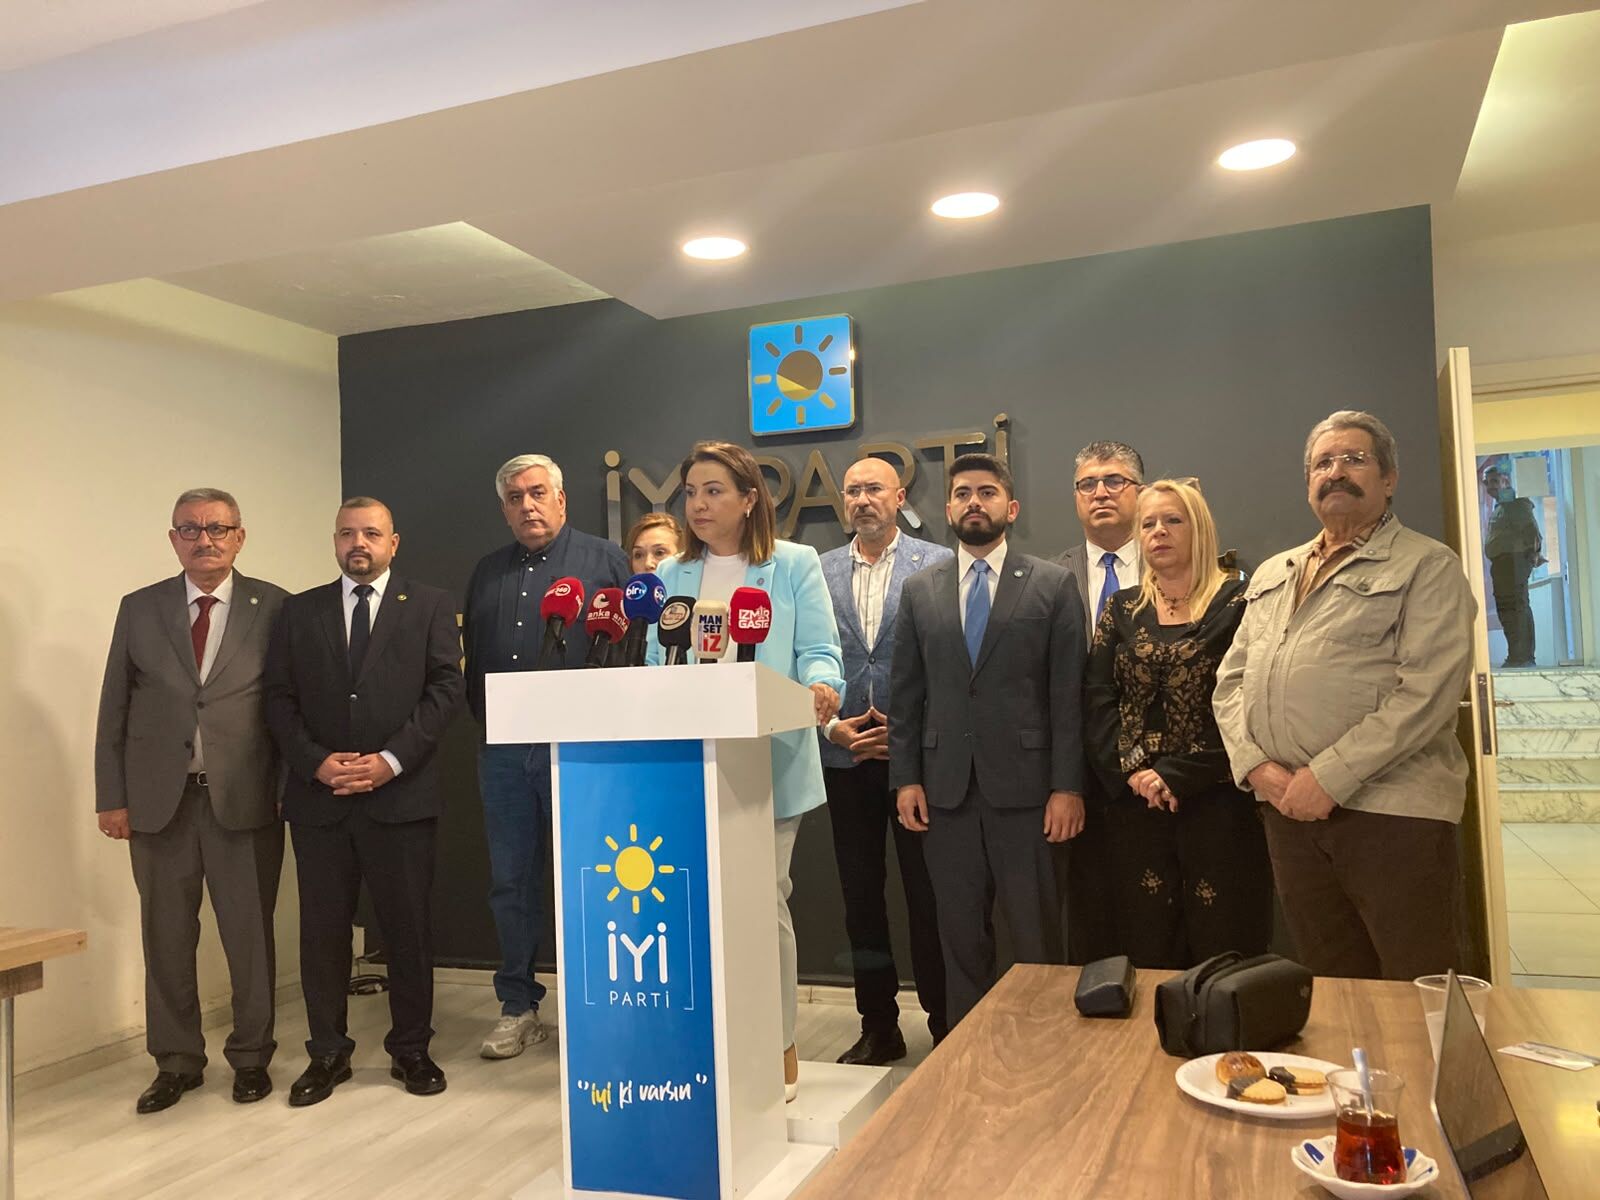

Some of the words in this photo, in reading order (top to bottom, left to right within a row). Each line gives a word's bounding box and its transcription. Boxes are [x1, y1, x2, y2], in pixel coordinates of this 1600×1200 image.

[588, 609, 610, 619] anka
[699, 615, 722, 624] MAN
[607, 921, 668, 984] İYİ
[609, 990, 670, 1009] PARTİ
